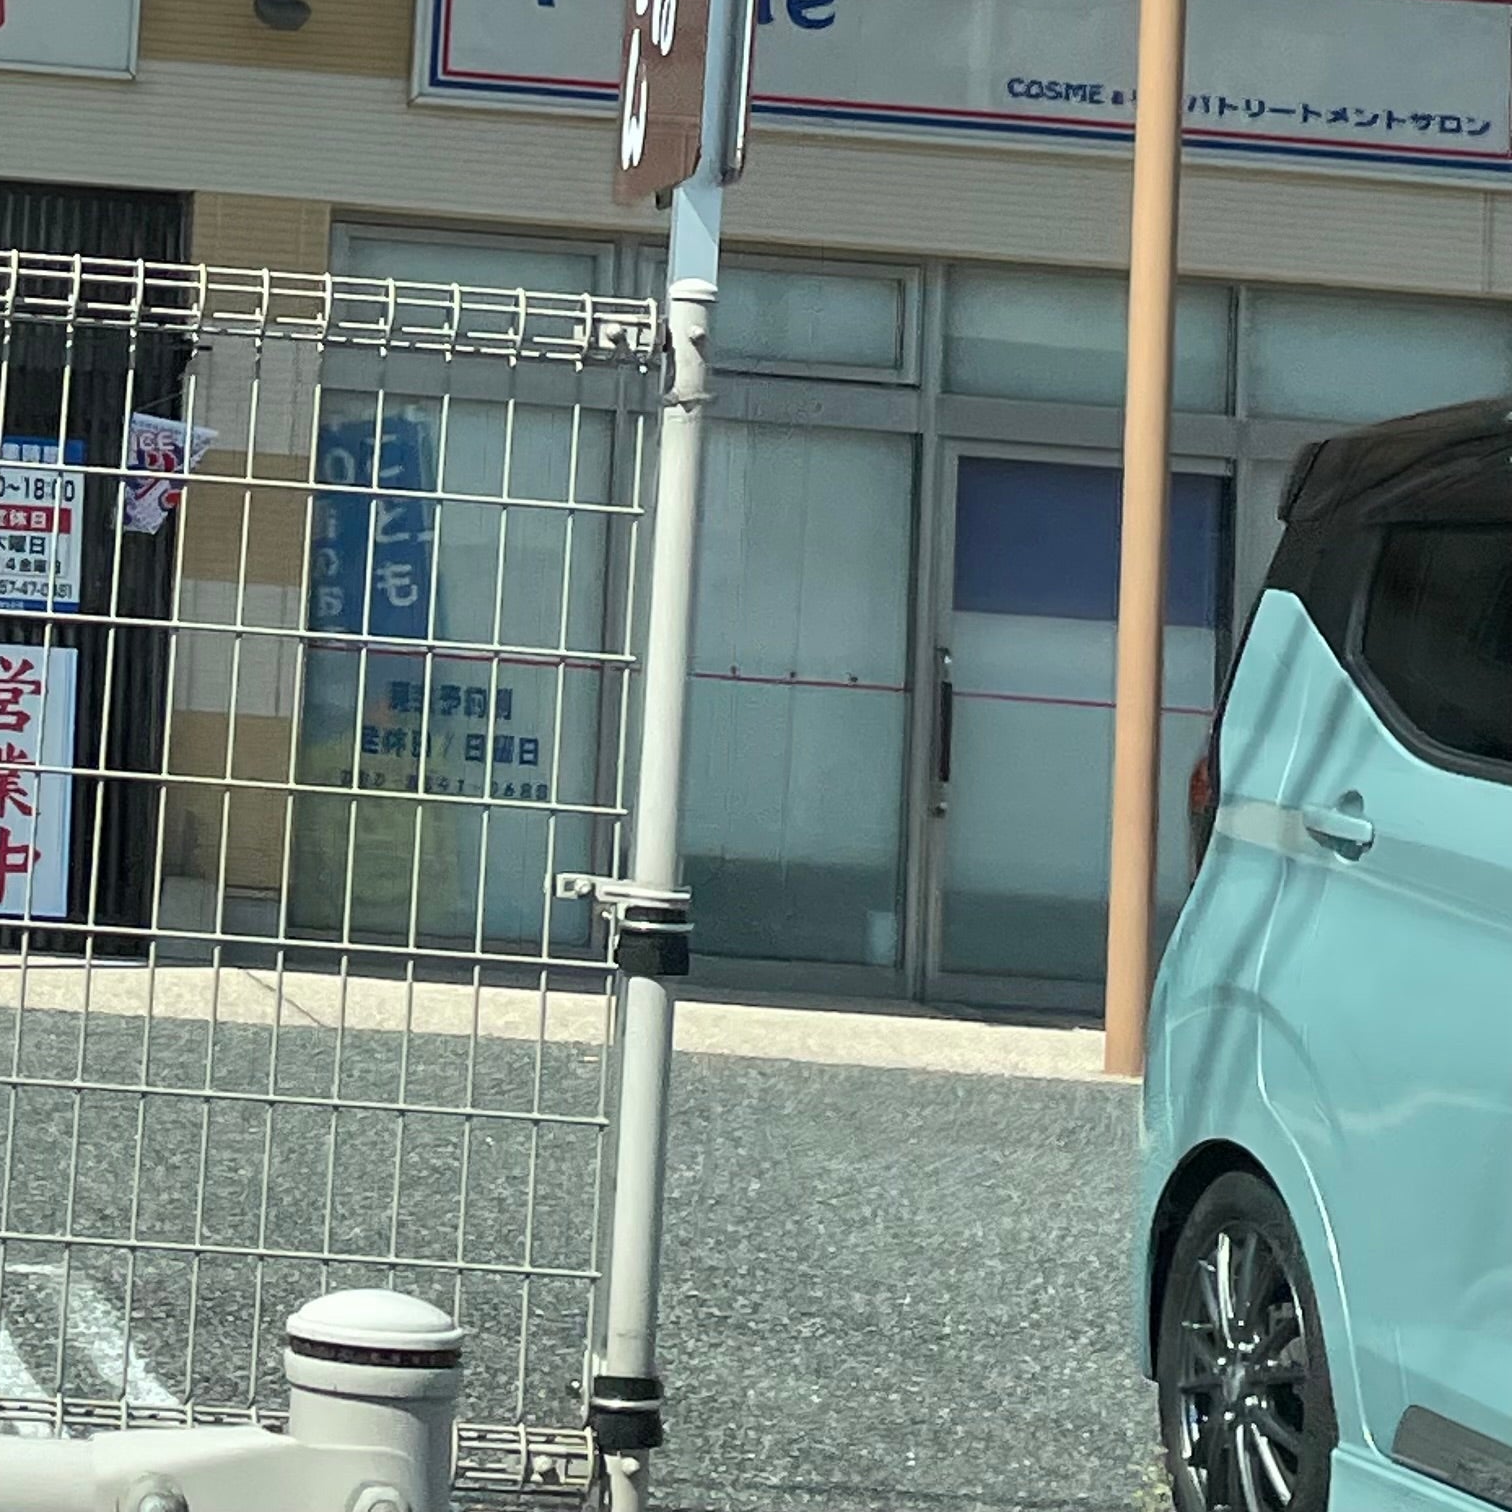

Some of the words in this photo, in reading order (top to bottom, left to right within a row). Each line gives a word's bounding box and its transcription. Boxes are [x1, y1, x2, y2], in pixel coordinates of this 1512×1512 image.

[1006, 76, 1106, 105] COSME
[1129, 91, 1492, 137] パトリートメントサロン
